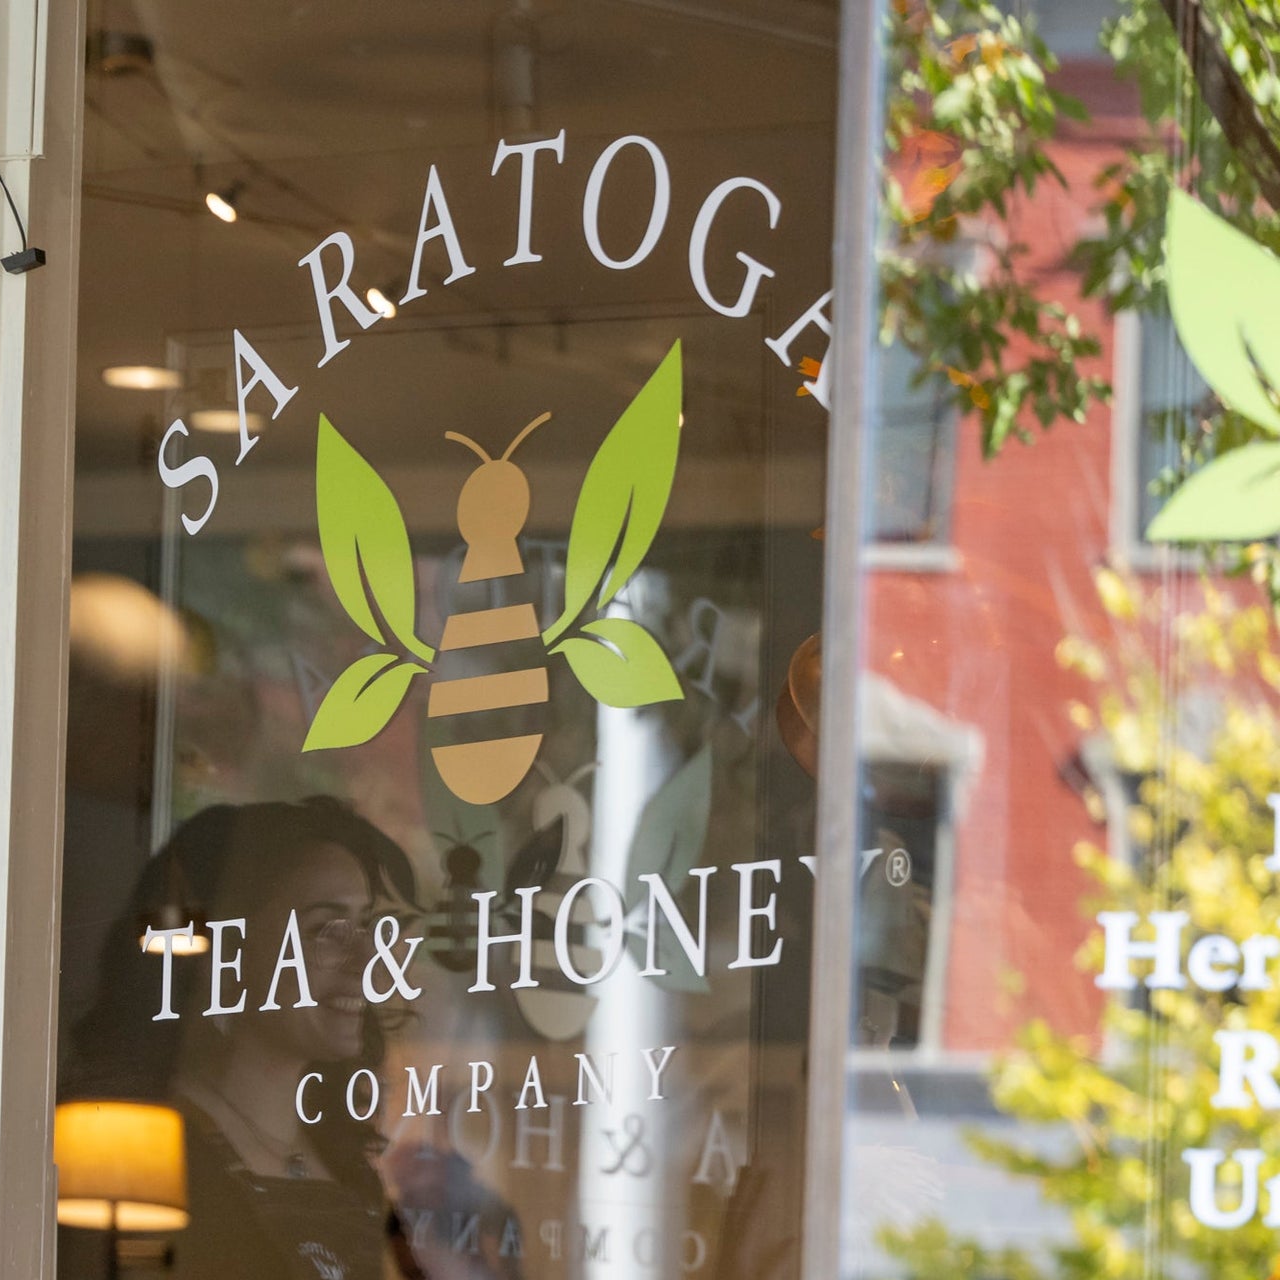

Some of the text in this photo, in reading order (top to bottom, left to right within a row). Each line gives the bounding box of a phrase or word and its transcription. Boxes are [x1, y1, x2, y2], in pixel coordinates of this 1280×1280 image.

[141, 909, 318, 1021] TEA
[362, 915, 424, 1003] &
[295, 1045, 679, 1125] COMPANY
